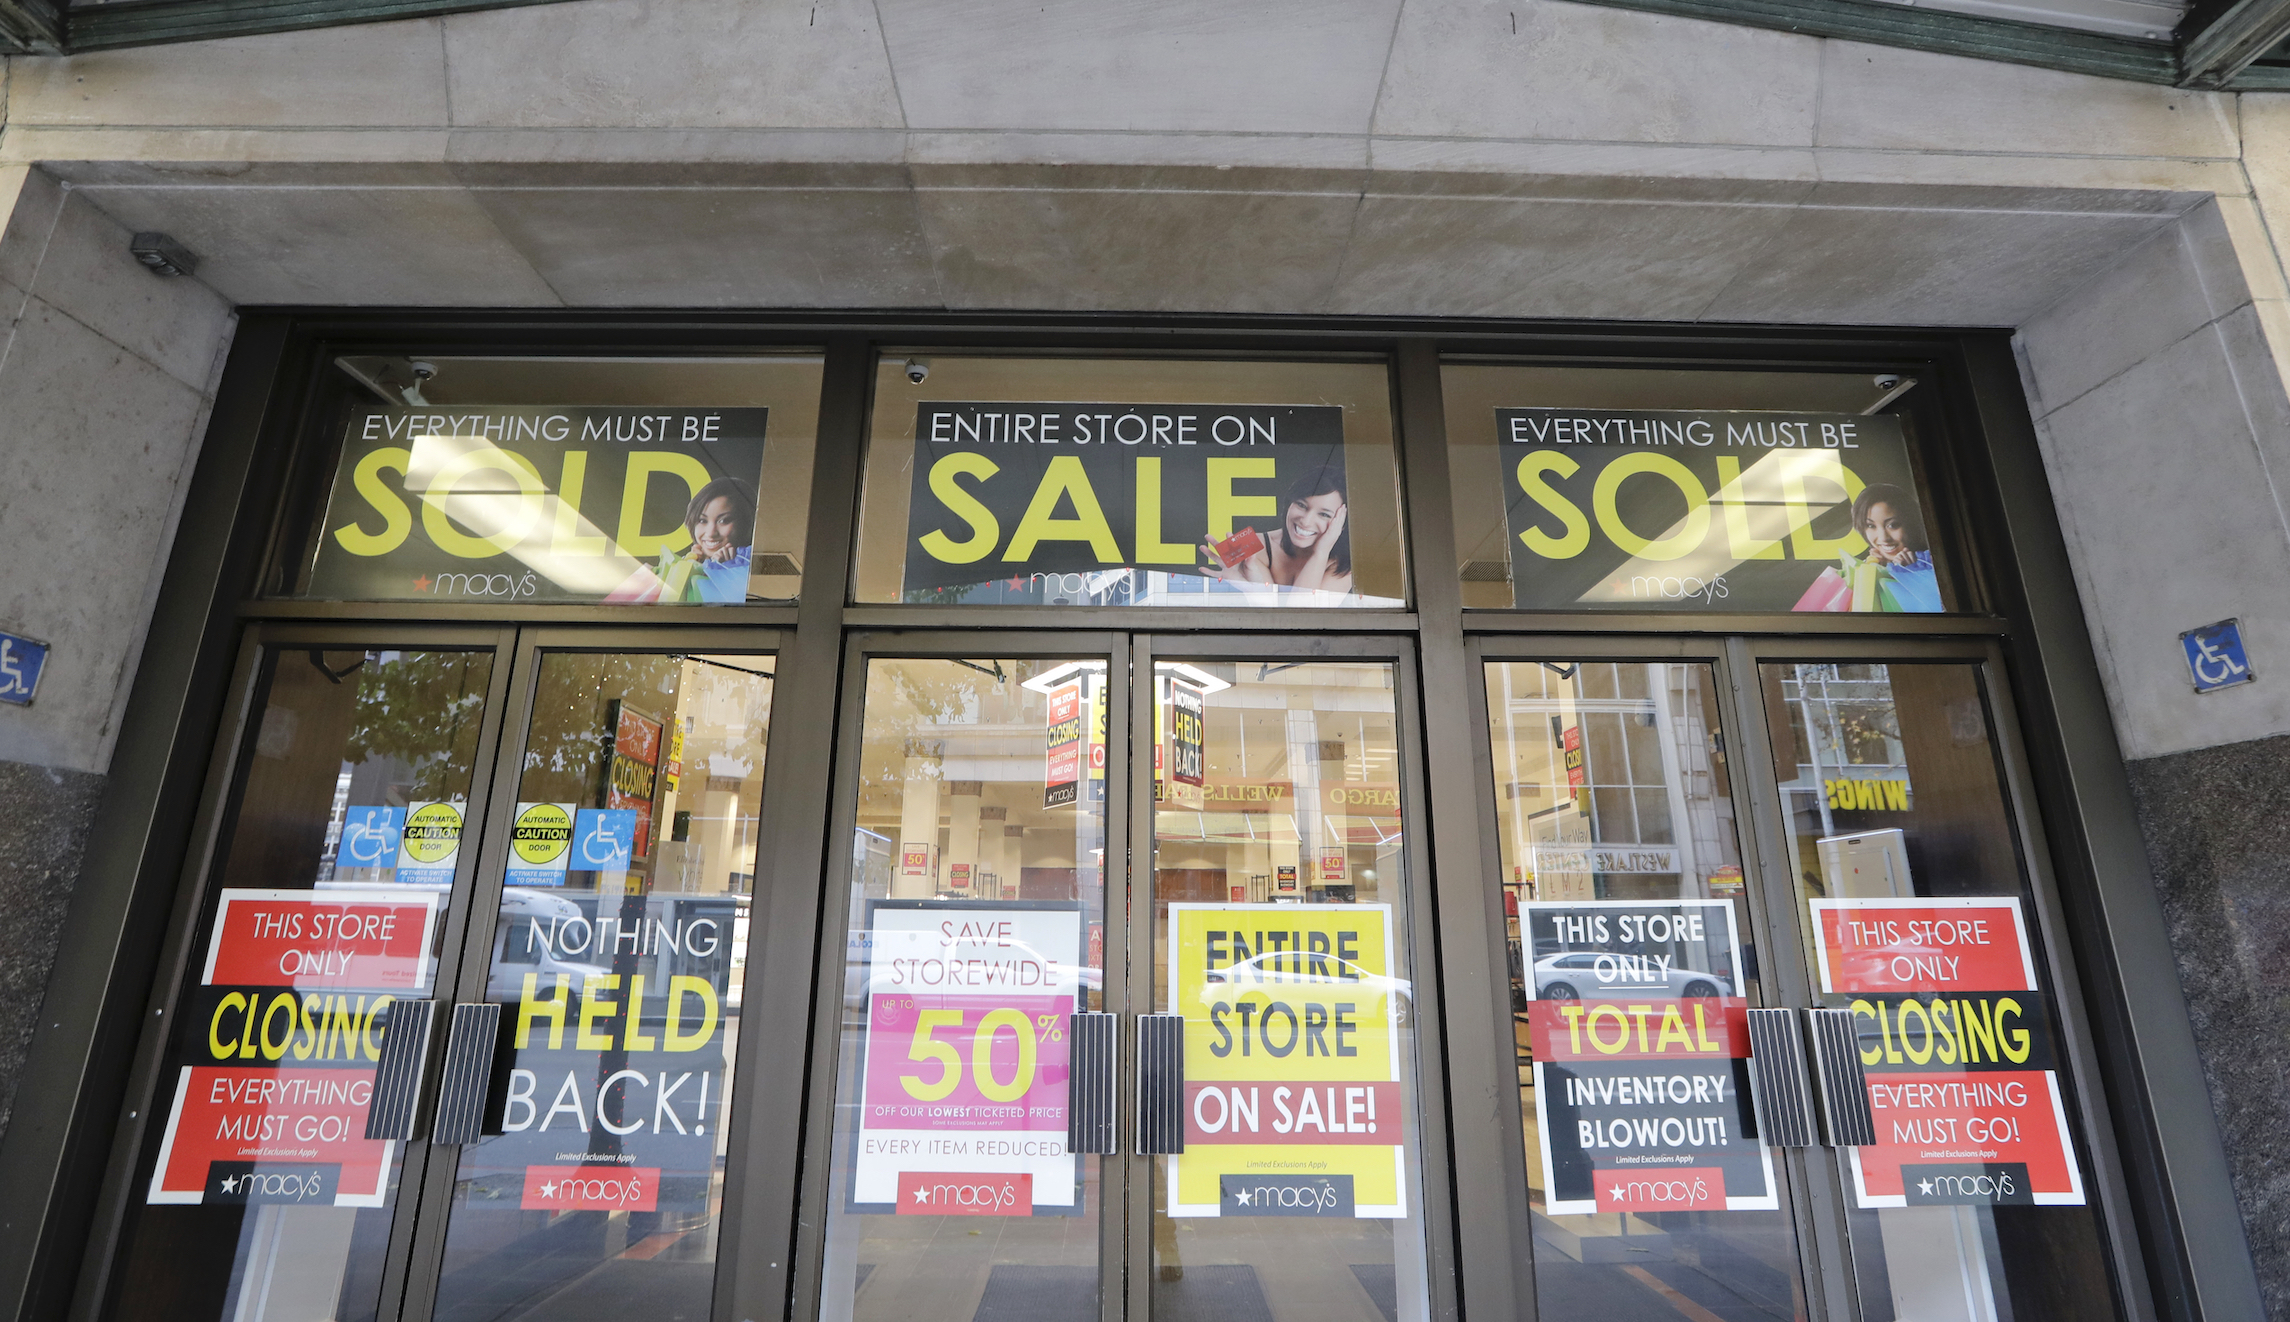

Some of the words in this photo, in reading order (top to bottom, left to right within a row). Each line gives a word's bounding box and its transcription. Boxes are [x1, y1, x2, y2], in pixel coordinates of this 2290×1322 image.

[362, 414, 569, 442] EVERYTHING
[581, 415, 671, 442] MUST
[681, 416, 721, 442] BE
[930, 412, 1061, 444] ENTIRE
[1073, 413, 1197, 446] STORE
[1211, 415, 1276, 447] ON
[1511, 417, 1715, 446] EVERYTHING
[1727, 422, 1810, 448] MUST
[1822, 423, 1859, 449] BE
[334, 447, 713, 559] SOLD
[918, 451, 1277, 564] SALE
[1517, 449, 1868, 562] SOLD
[434, 569, 537, 601] macy's
[1030, 571, 1133, 597] macy's
[1632, 573, 1729, 604] macy's
[1052, 697, 1061, 707] THIS
[1062, 691, 1076, 704] STORE
[1057, 704, 1070, 716] ONLY
[1175, 690, 1201, 714] NOTHING
[1048, 719, 1079, 747] CLOSING
[1176, 711, 1202, 746] HELD
[1050, 750, 1076, 765] EVERYTHING
[1051, 765, 1063, 777] MUST
[1064, 763, 1073, 773] GO!
[1176, 746, 1202, 780] BACK!
[612, 756, 653, 798] CLOSING
[1052, 785, 1074, 801] macy's
[408, 828, 459, 838] CAUTION
[517, 829, 568, 839] CAUTION
[253, 912, 304, 940] THIS
[310, 914, 396, 941] STORE
[526, 916, 719, 957] NOTHING
[940, 921, 1012, 947] SAVE
[1552, 915, 1610, 944] THIS
[1619, 914, 1705, 942] STORE
[1849, 920, 1901, 945] THIS
[1908, 920, 1990, 945] STORE
[279, 949, 355, 976] ONLY
[891, 958, 1058, 986] STOREWIDE
[1206, 931, 1359, 984] ENTIRE
[1593, 954, 1671, 983] ONLY
[1891, 956, 1959, 982] ONLY
[514, 972, 719, 1052] HELD
[882, 999, 896, 1009] UP
[899, 1000, 914, 1009] TO
[208, 991, 397, 1062] CLOSING
[1209, 1001, 1358, 1058] STORE
[1561, 1003, 1720, 1054] TOTAL
[1850, 997, 2031, 1066] CLOSING
[209, 1078, 372, 1106] EVERYTHING
[501, 1068, 709, 1137] BACK!
[1566, 1075, 1727, 1106] INVENTORY
[1872, 1081, 2027, 1109] EVERYTHING
[875, 1106, 896, 1117] OFF
[900, 1106, 924, 1117] OUR
[928, 1107, 970, 1118] LOWEST
[974, 1107, 1025, 1118] TICKETED
[1029, 1108, 1062, 1118] PRICE
[1193, 1085, 1260, 1134] ON
[1272, 1085, 1377, 1134] SALE!
[216, 1114, 289, 1141] MUST
[295, 1116, 351, 1142] GO!
[1578, 1116, 1728, 1149] BLOWOUT!
[1893, 1118, 1957, 1144] MUST
[1966, 1116, 2021, 1144] GO!
[237, 1147, 262, 1156] Limited
[263, 1147, 297, 1157] Exclusions
[298, 1148, 318, 1158] Apply
[555, 1152, 581, 1161] Limited
[582, 1152, 615, 1162] Exclusions
[616, 1153, 637, 1164] Apply
[866, 1139, 921, 1155] EVERY
[929, 1140, 969, 1155] ITEM
[977, 1141, 1068, 1157] REDUCED!
[1616, 1155, 1640, 1164] Limited
[1641, 1155, 1674, 1164] Exclusions
[1674, 1155, 1694, 1164] Apply
[1920, 1150, 1945, 1158] Limited
[1945, 1150, 1977, 1158] Exclusions
[1978, 1149, 1997, 1159] Apply
[1246, 1160, 1272, 1169] Limited
[1272, 1160, 1307, 1169] Exclusions
[1308, 1160, 1328, 1170] Apply
[238, 1171, 321, 1202] macy's
[559, 1176, 641, 1207] macy's
[932, 1181, 1015, 1212] macy's
[1254, 1183, 1337, 1214] macy's
[1627, 1176, 1708, 1207] macy's
[1935, 1171, 2015, 1201] macy's
